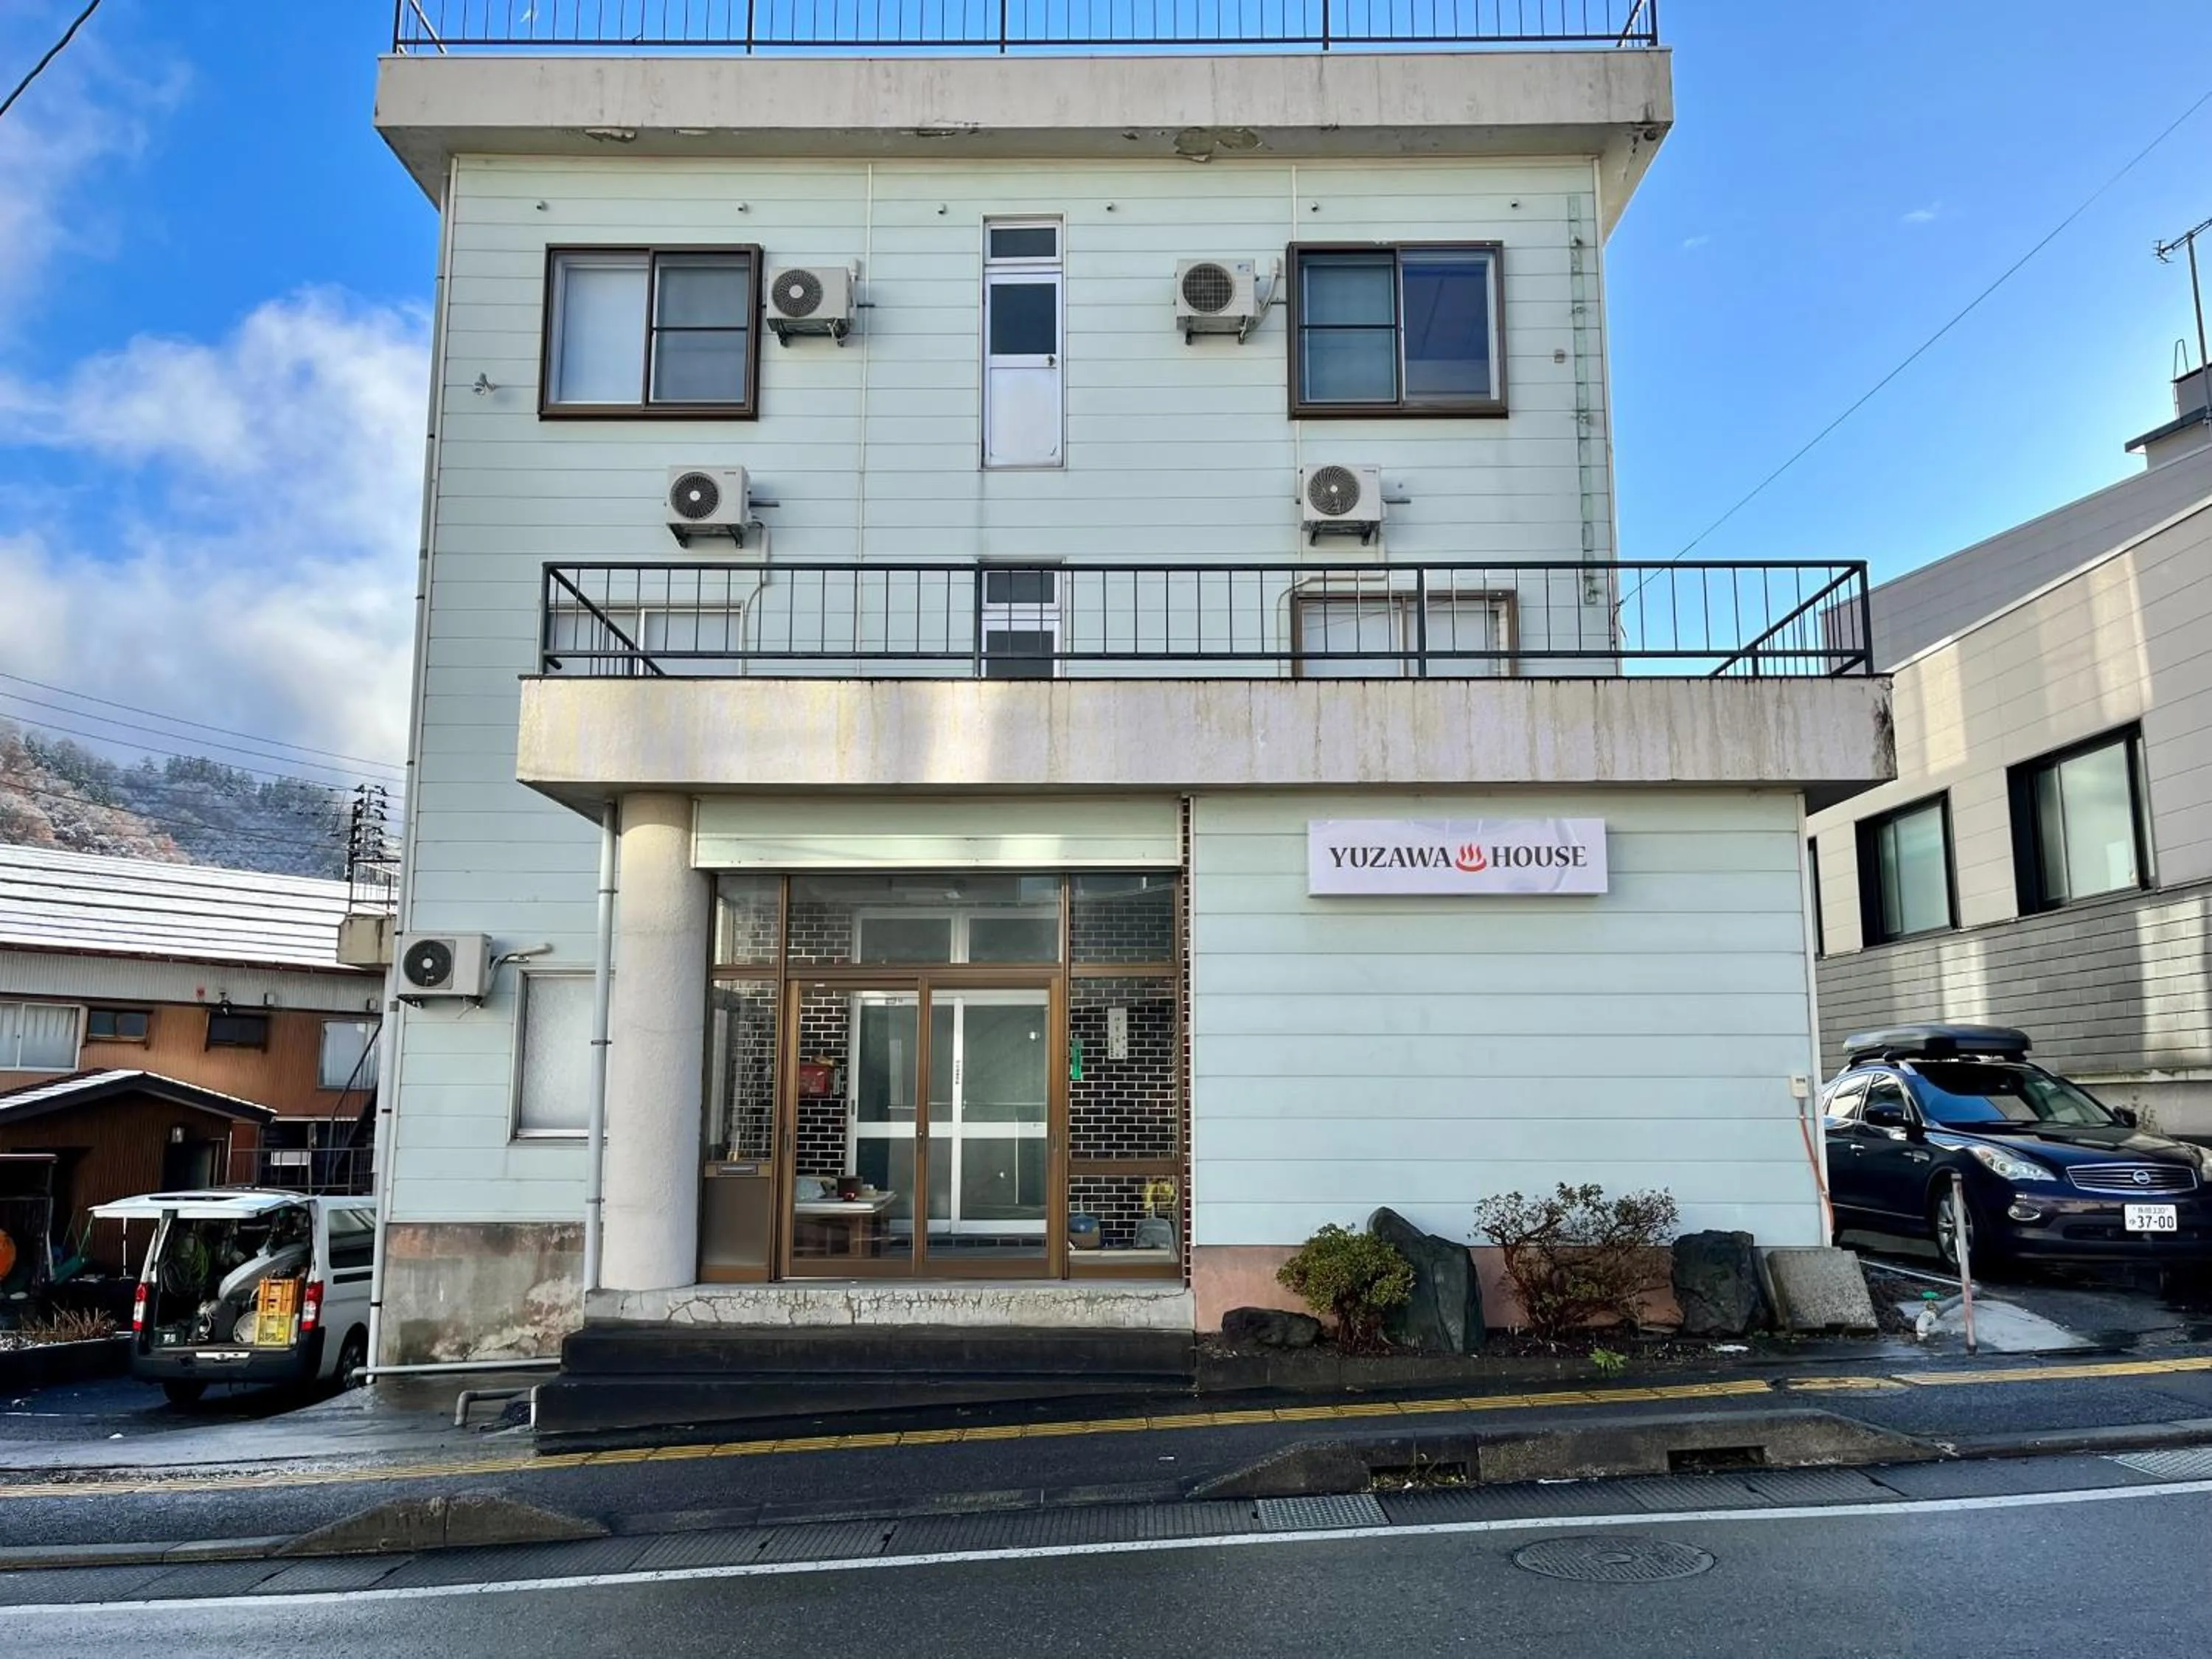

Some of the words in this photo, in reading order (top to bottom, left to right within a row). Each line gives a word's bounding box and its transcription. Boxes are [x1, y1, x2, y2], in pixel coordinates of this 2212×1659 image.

[1329, 846, 1452, 868] YUZAWA
[1492, 846, 1587, 868] HOUSE
[2138, 1215, 2174, 1228] 37-00
